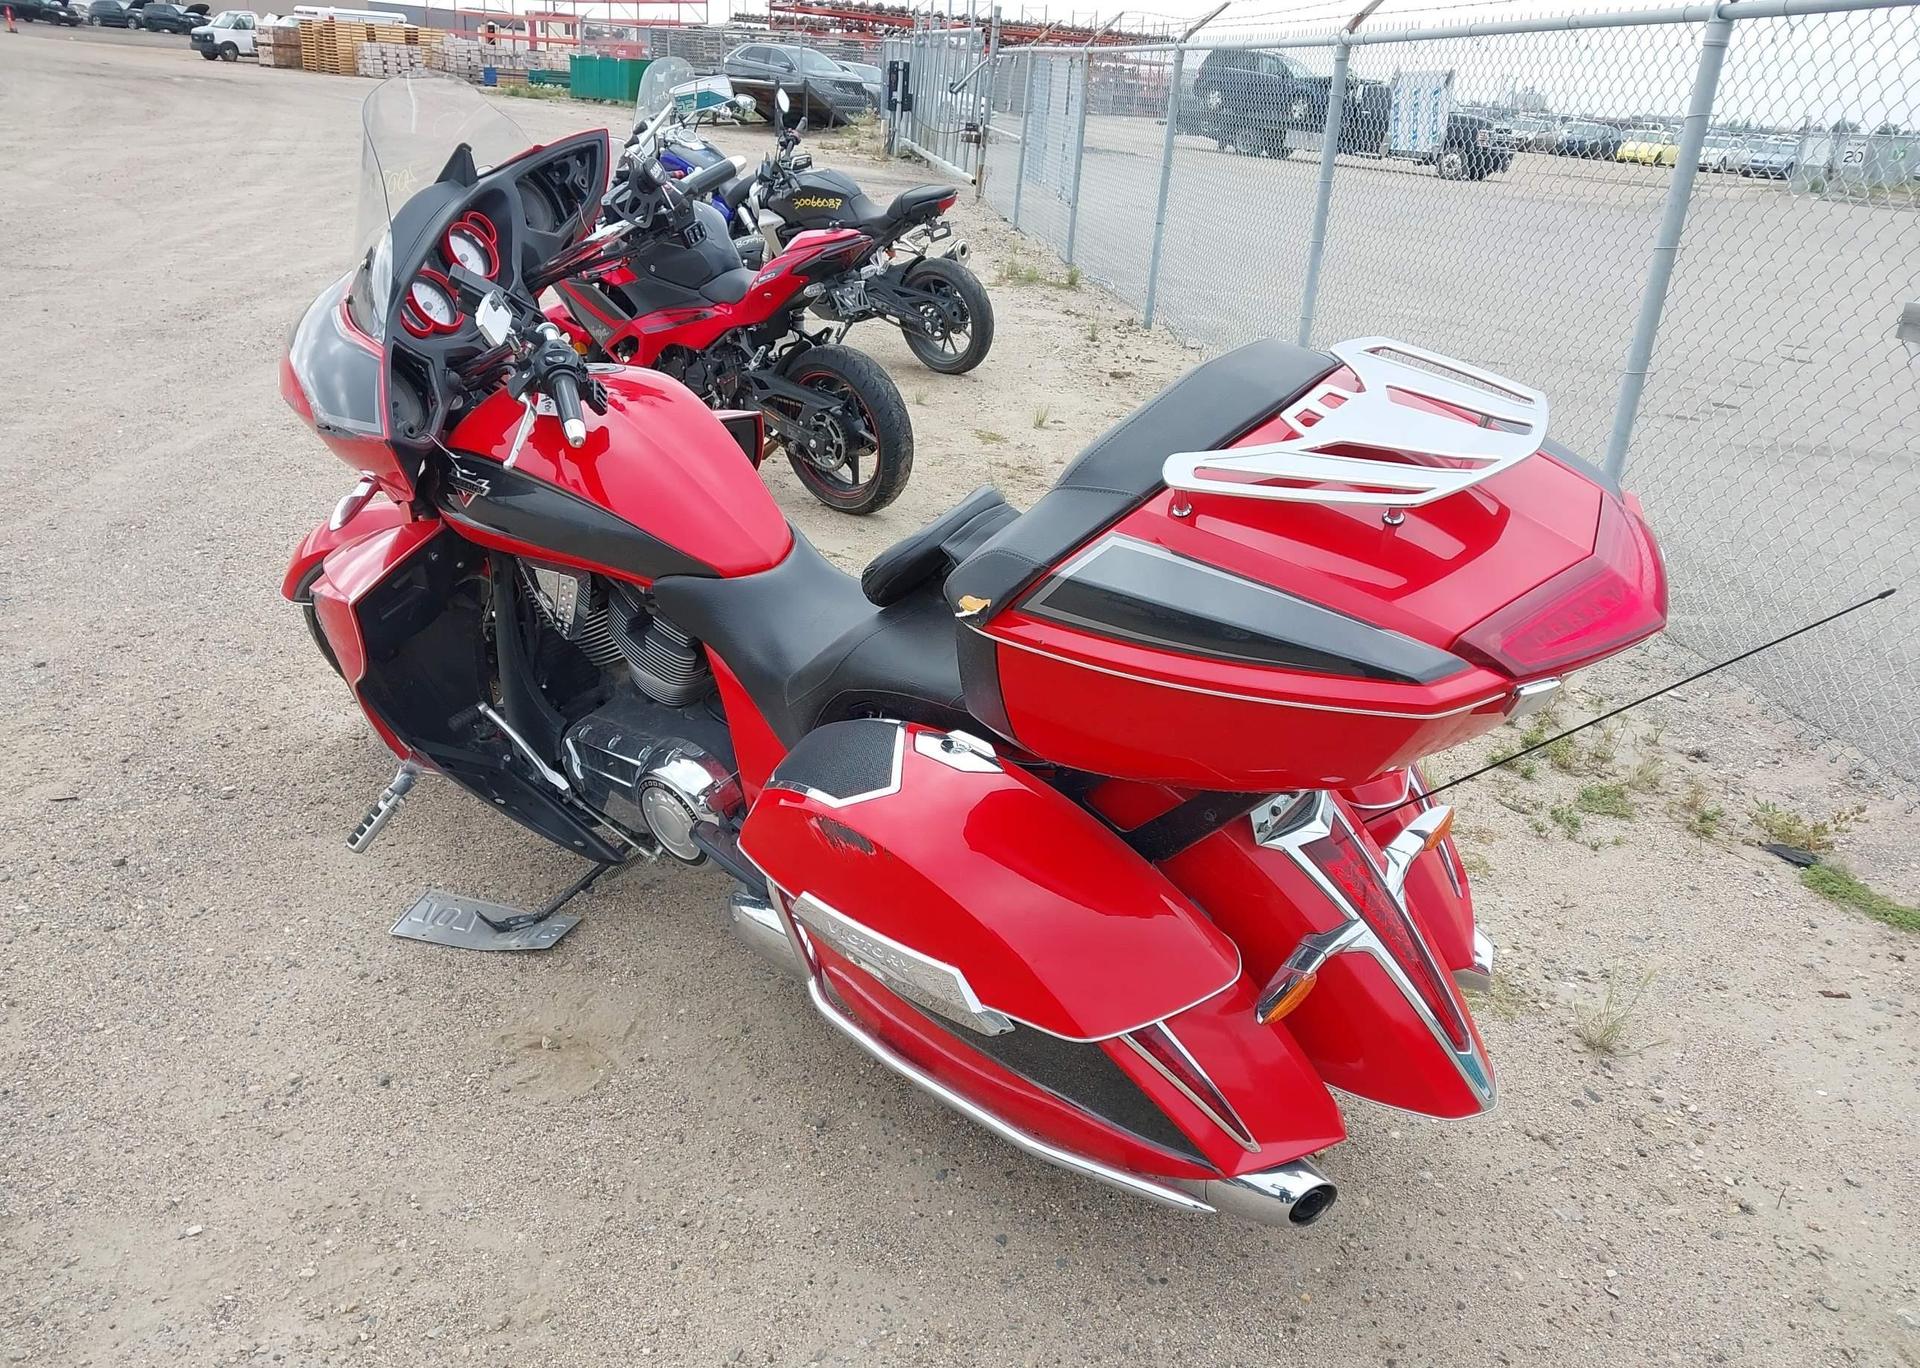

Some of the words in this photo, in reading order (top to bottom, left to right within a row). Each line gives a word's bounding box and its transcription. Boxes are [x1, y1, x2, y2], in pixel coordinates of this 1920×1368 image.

[1843, 150, 1864, 163] 20
[792, 195, 842, 210] 30066087
[826, 919, 916, 975] VICTORY
